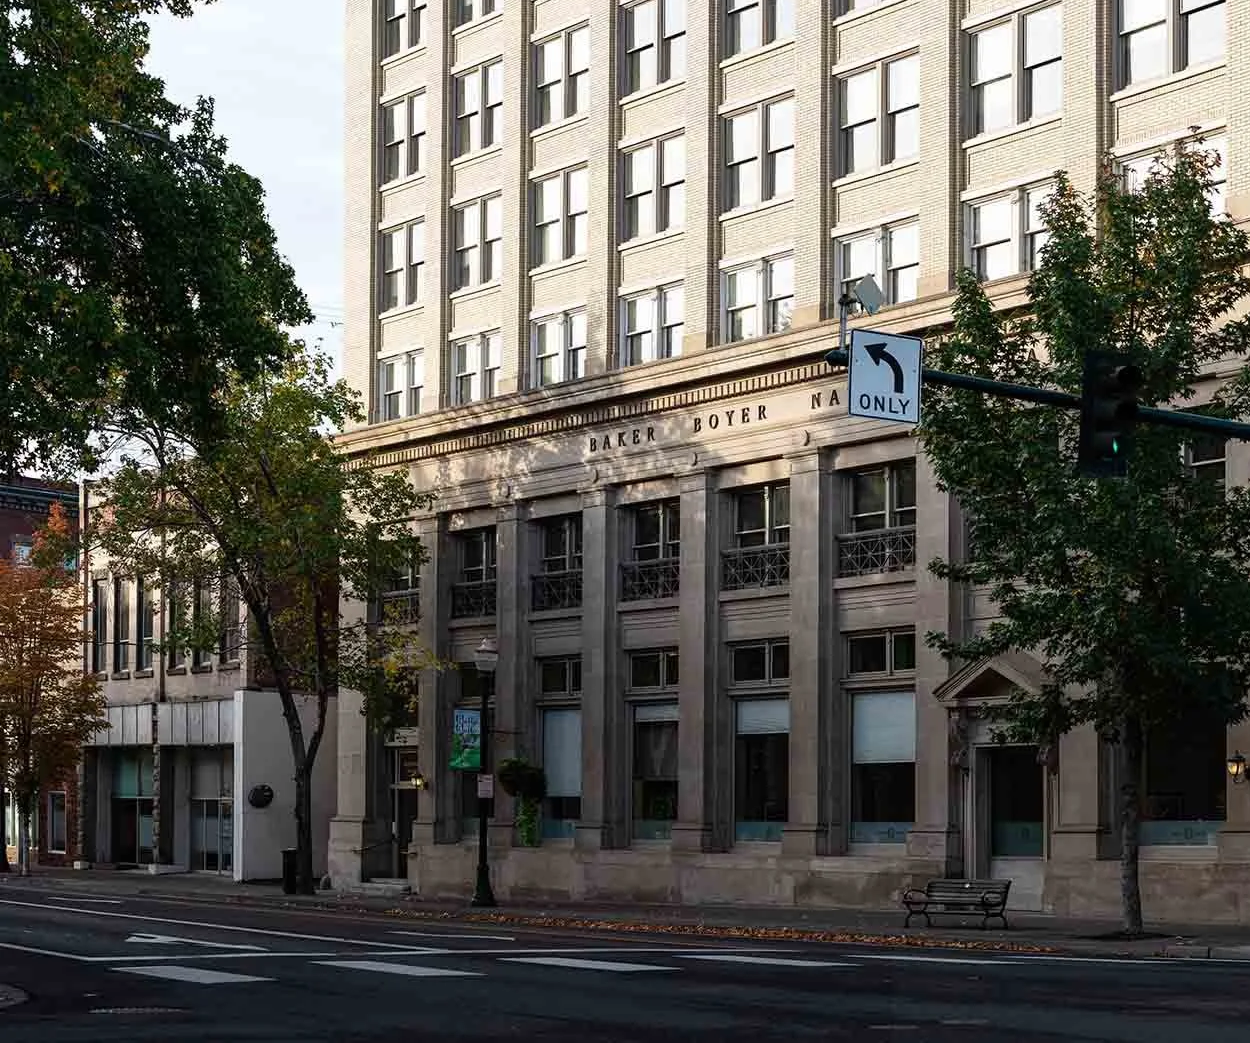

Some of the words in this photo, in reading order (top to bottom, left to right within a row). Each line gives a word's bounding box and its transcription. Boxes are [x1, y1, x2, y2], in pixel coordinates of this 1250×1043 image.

[859, 393, 911, 415] ONLY
[589, 427, 656, 452] BAKER
[693, 404, 768, 433] BOYER
